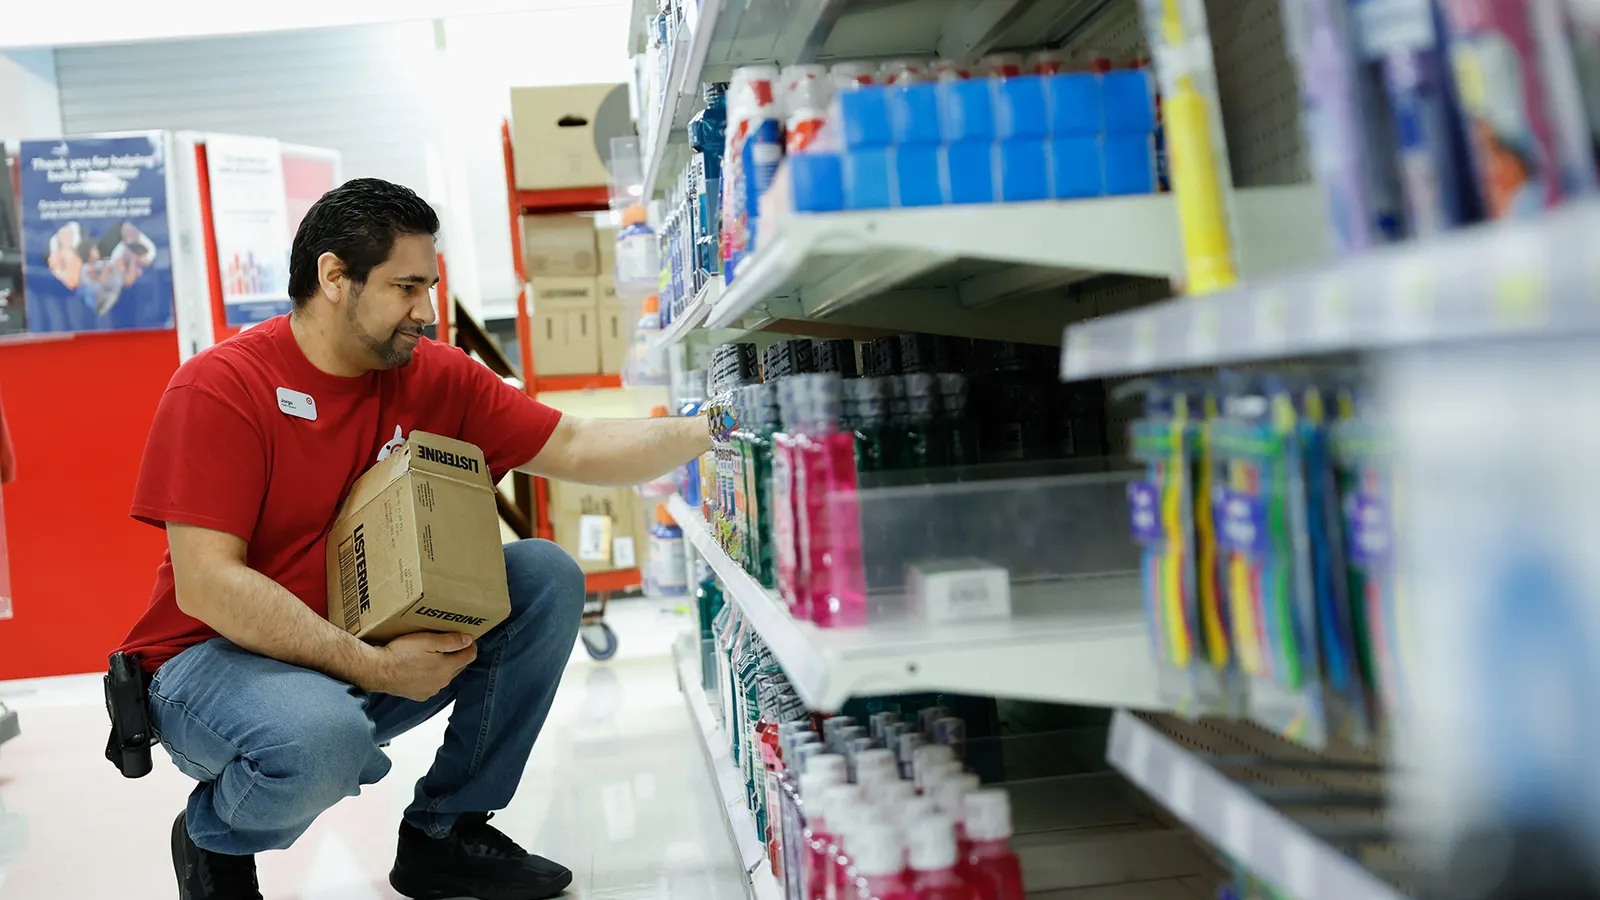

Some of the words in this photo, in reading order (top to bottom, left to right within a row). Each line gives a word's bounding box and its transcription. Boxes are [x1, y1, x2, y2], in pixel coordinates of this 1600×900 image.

[417, 444, 479, 474] LISTERINE
[353, 523, 371, 615] LISTERINE
[414, 606, 487, 626] LISTERINE
